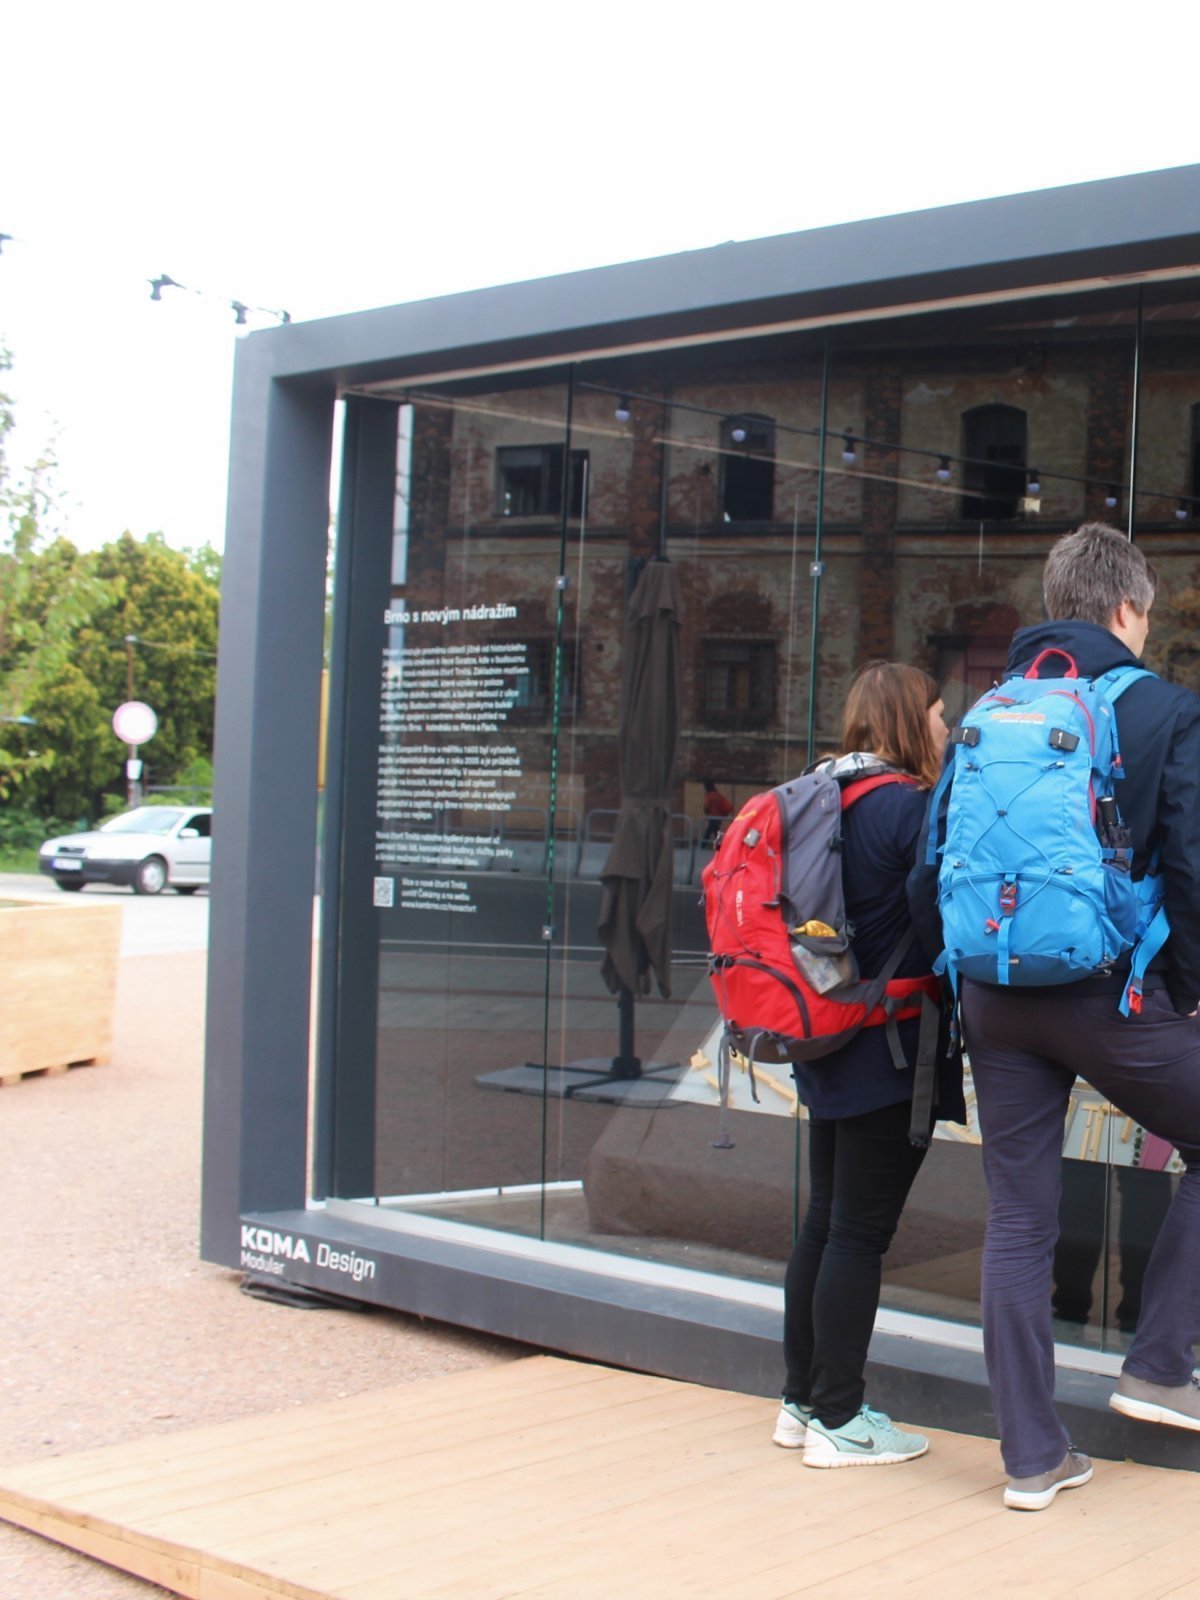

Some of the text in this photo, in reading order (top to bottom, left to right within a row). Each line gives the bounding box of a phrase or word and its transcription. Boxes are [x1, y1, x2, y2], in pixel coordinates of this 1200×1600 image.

[384, 603, 517, 626] Brno s novým nádražím
[240, 1225, 376, 1282] KOMA Design
[240, 1250, 285, 1276] Modular
